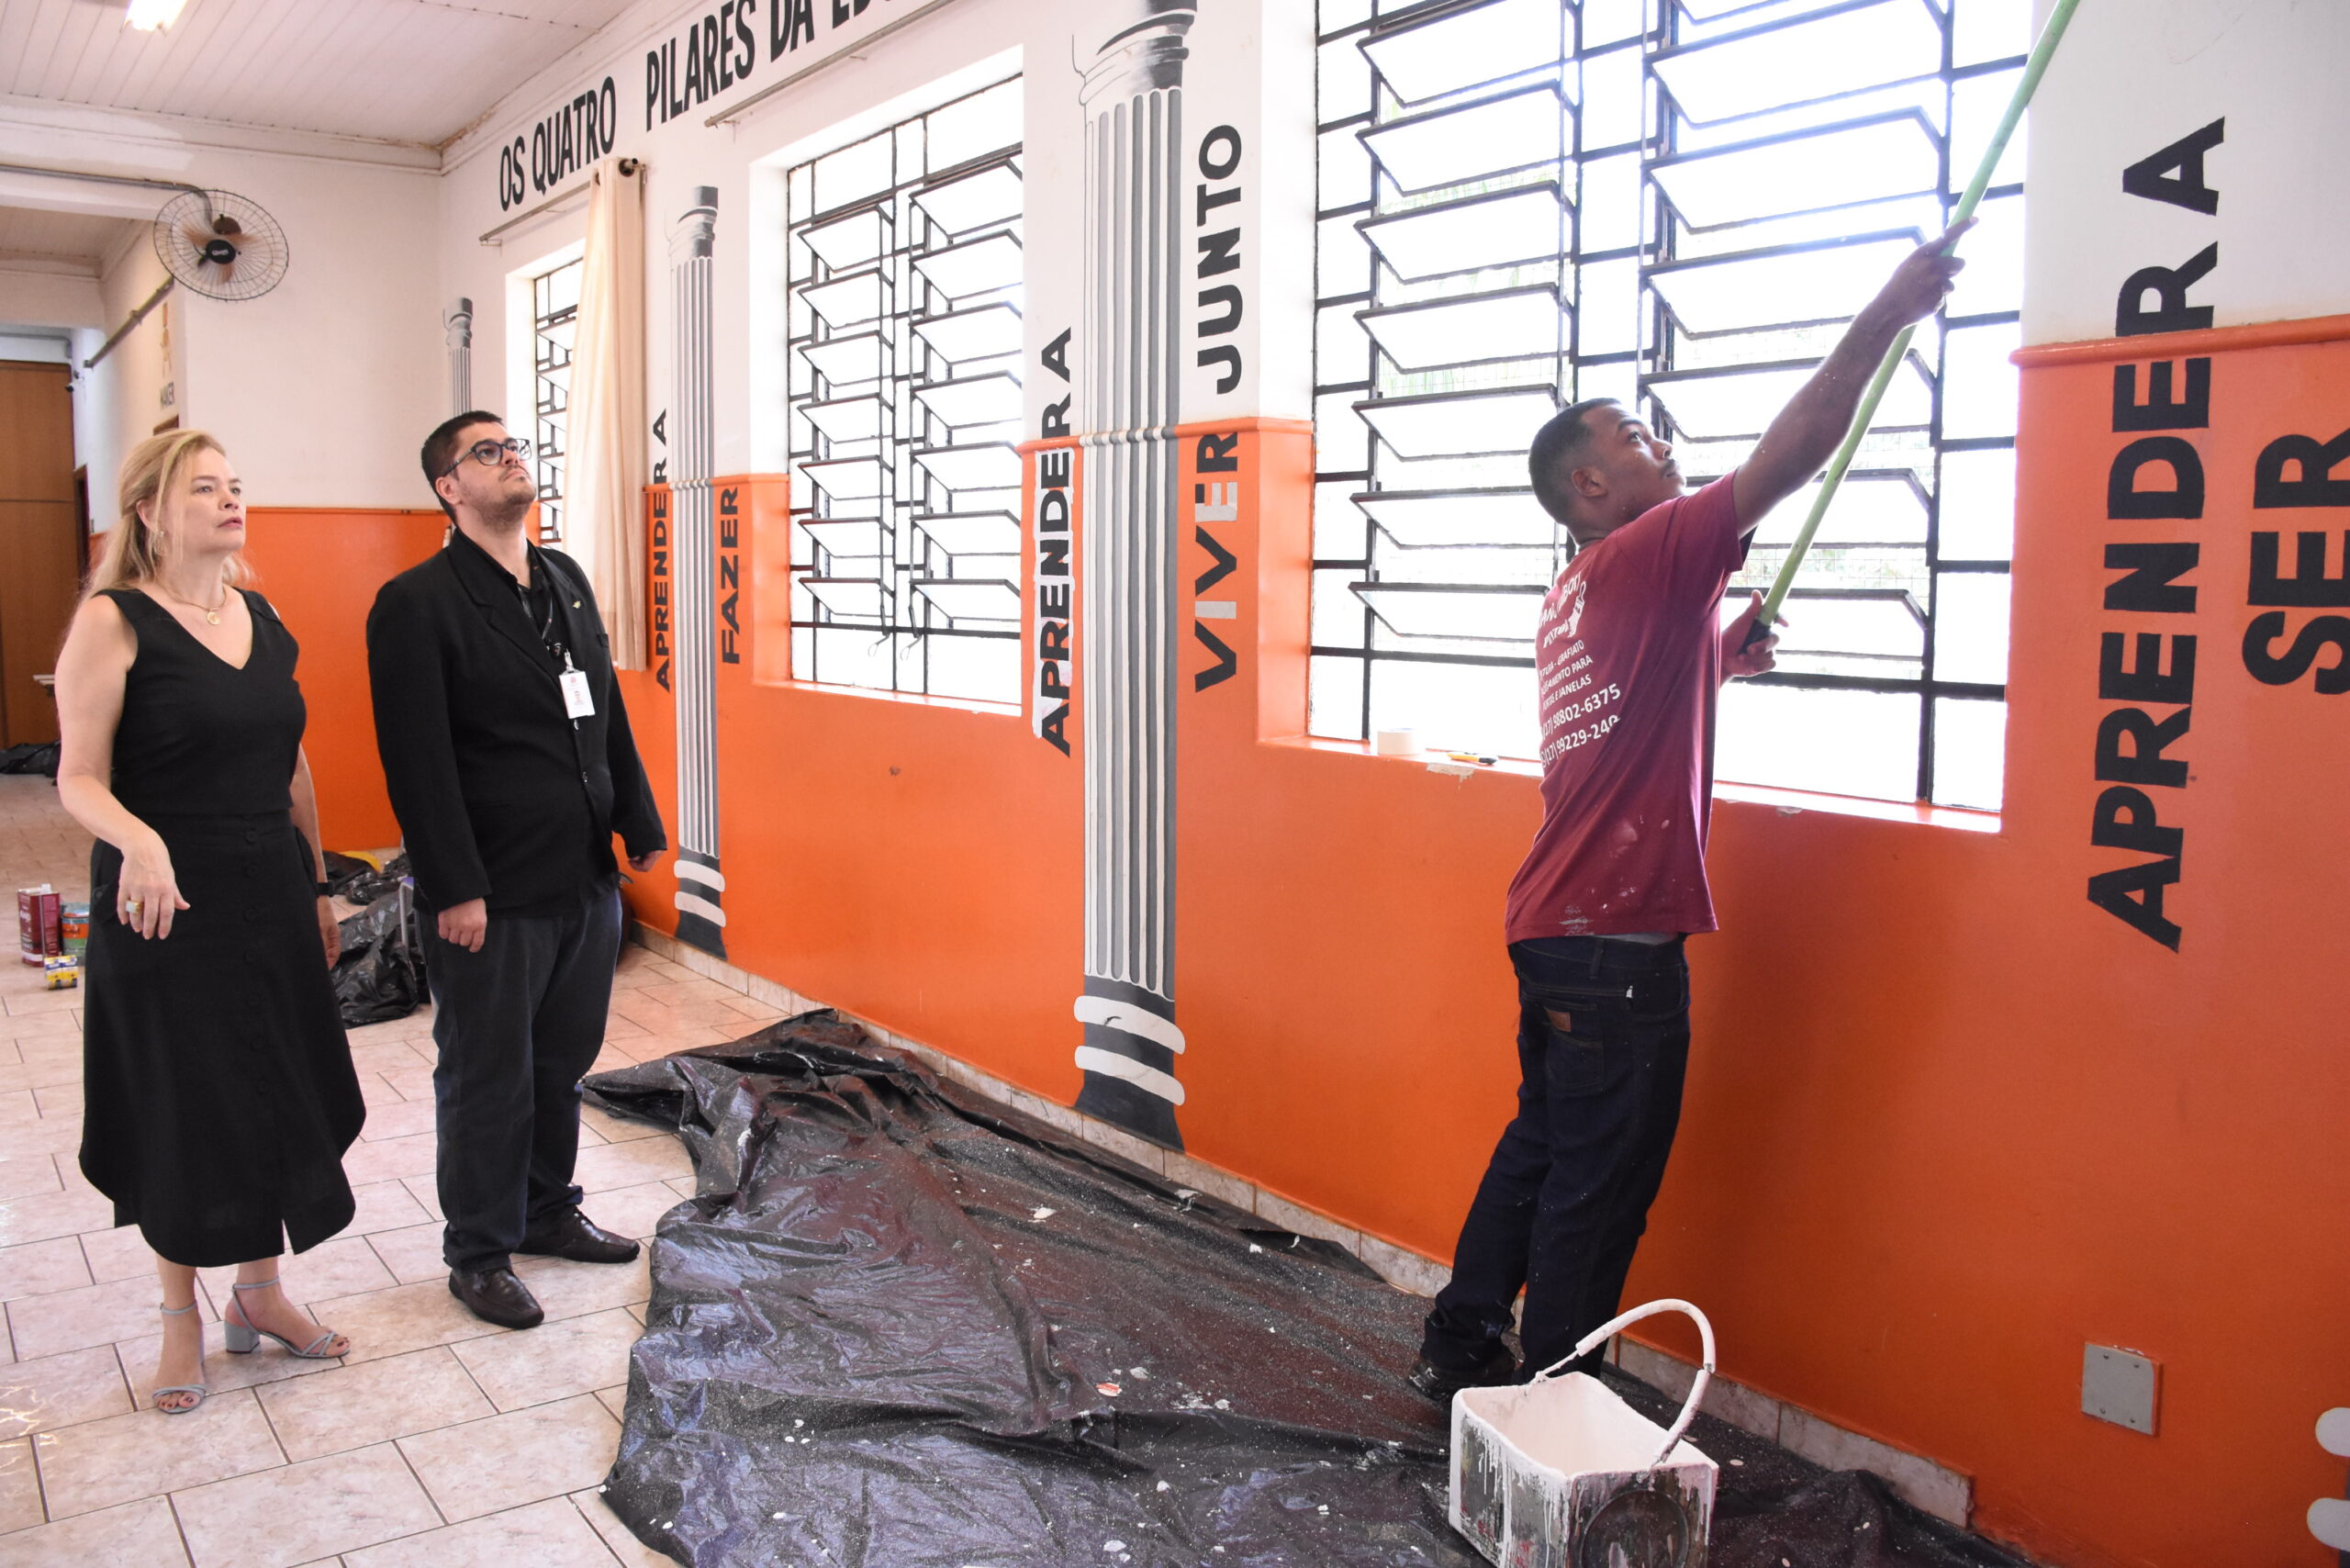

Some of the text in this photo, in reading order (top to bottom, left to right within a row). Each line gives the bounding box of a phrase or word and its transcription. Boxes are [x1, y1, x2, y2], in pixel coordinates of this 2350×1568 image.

[499, 135, 526, 212] OS
[532, 75, 617, 196] QUATRO
[646, 0, 755, 132] PILARES
[1194, 124, 1242, 693] VIVER JUNTO
[653, 409, 670, 693] APRENDER A
[721, 487, 740, 665] FAZER
[1040, 326, 1071, 757] APRENDER A
[2087, 116, 2226, 954] APRENDER A
[2242, 428, 2350, 695] SER
[1553, 683, 1621, 729] 98802-6375
[1559, 674, 1592, 698] JANELAS
[1572, 655, 1593, 674] PARA
